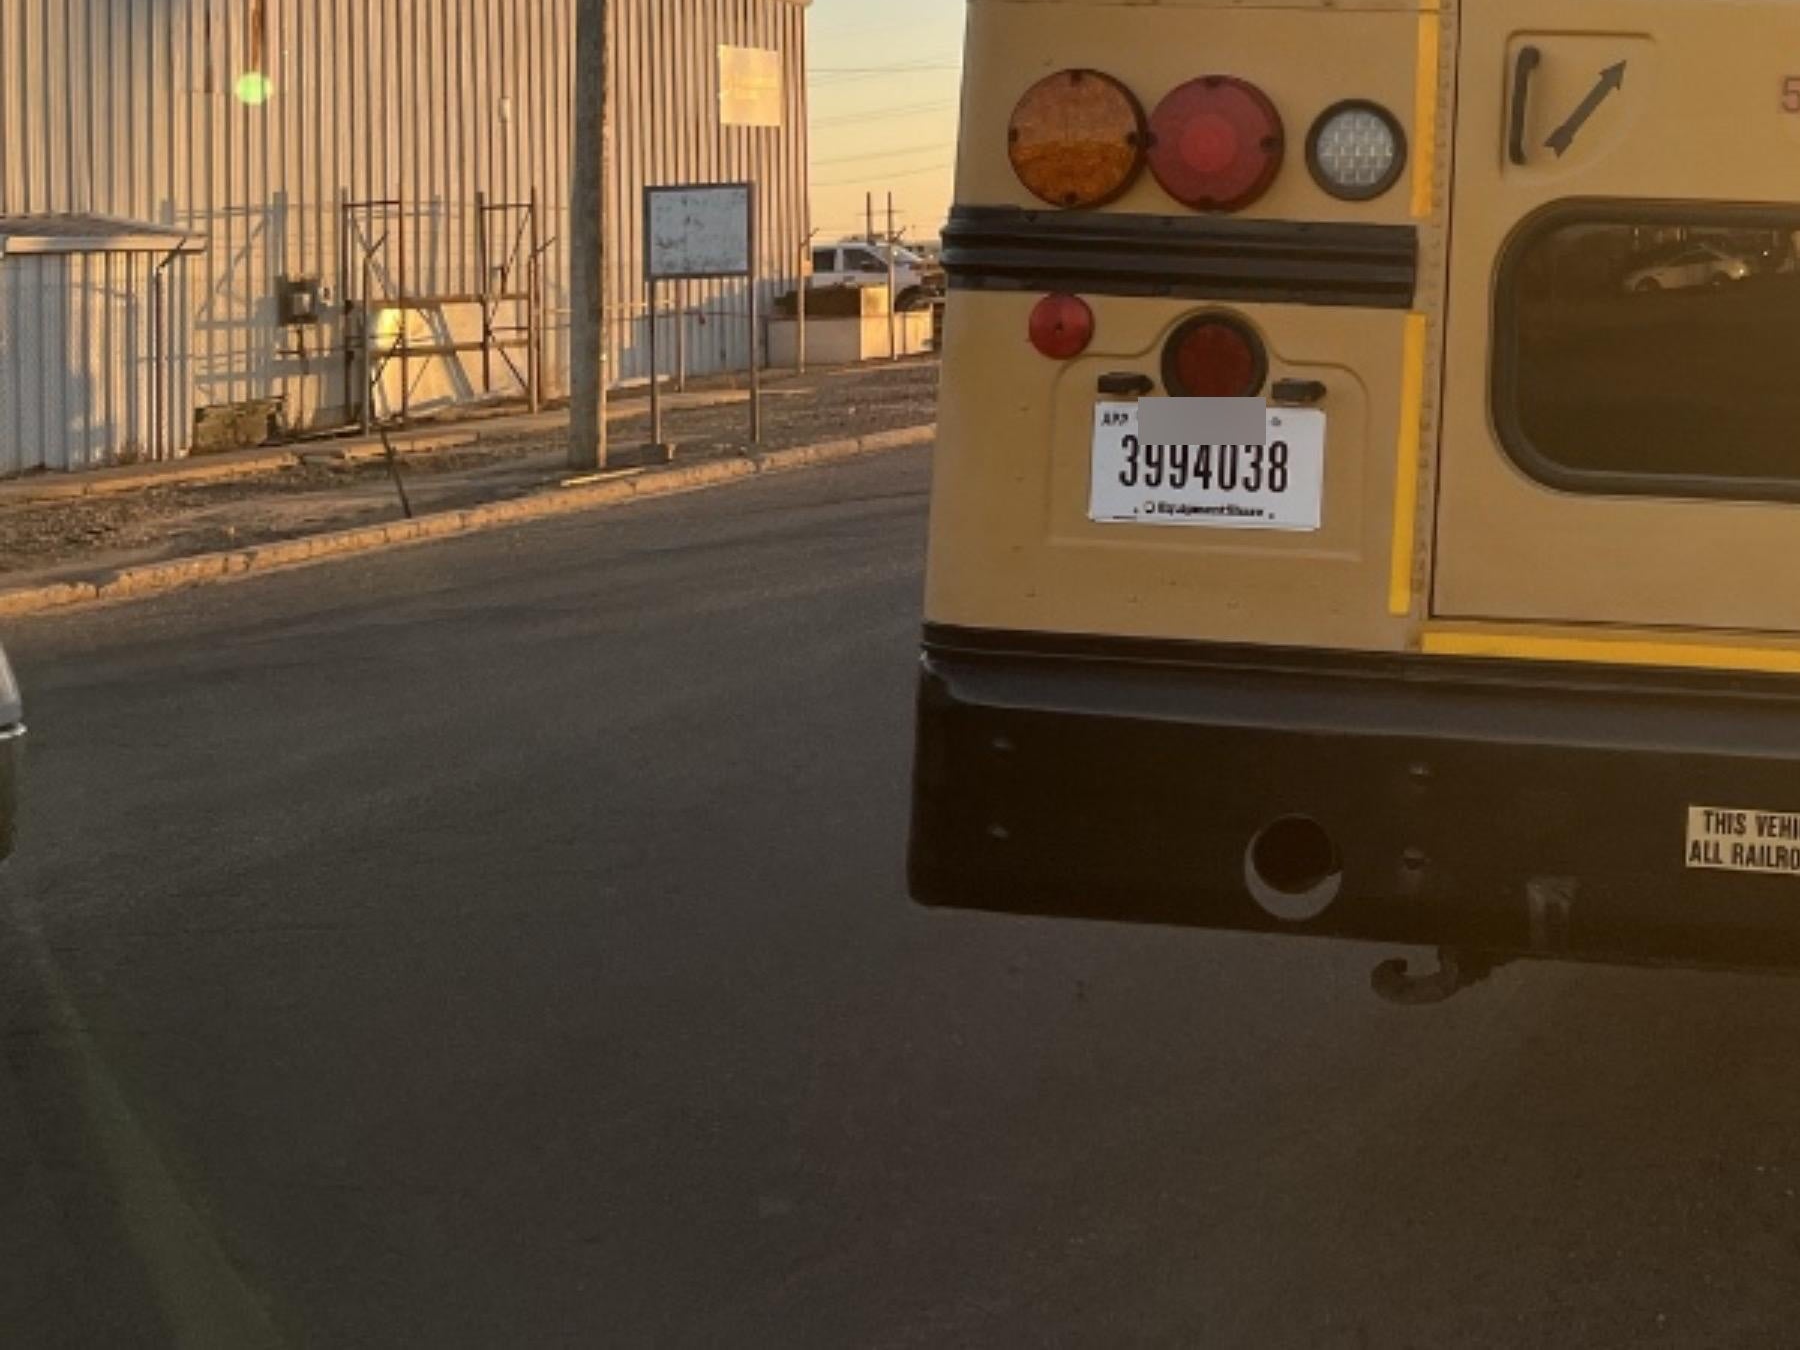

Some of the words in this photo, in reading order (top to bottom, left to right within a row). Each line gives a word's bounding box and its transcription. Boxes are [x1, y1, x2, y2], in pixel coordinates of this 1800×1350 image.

[1119, 434, 1289, 493] 3994038
[1702, 810, 1747, 836] THIS
[1689, 840, 1722, 864] ALL
